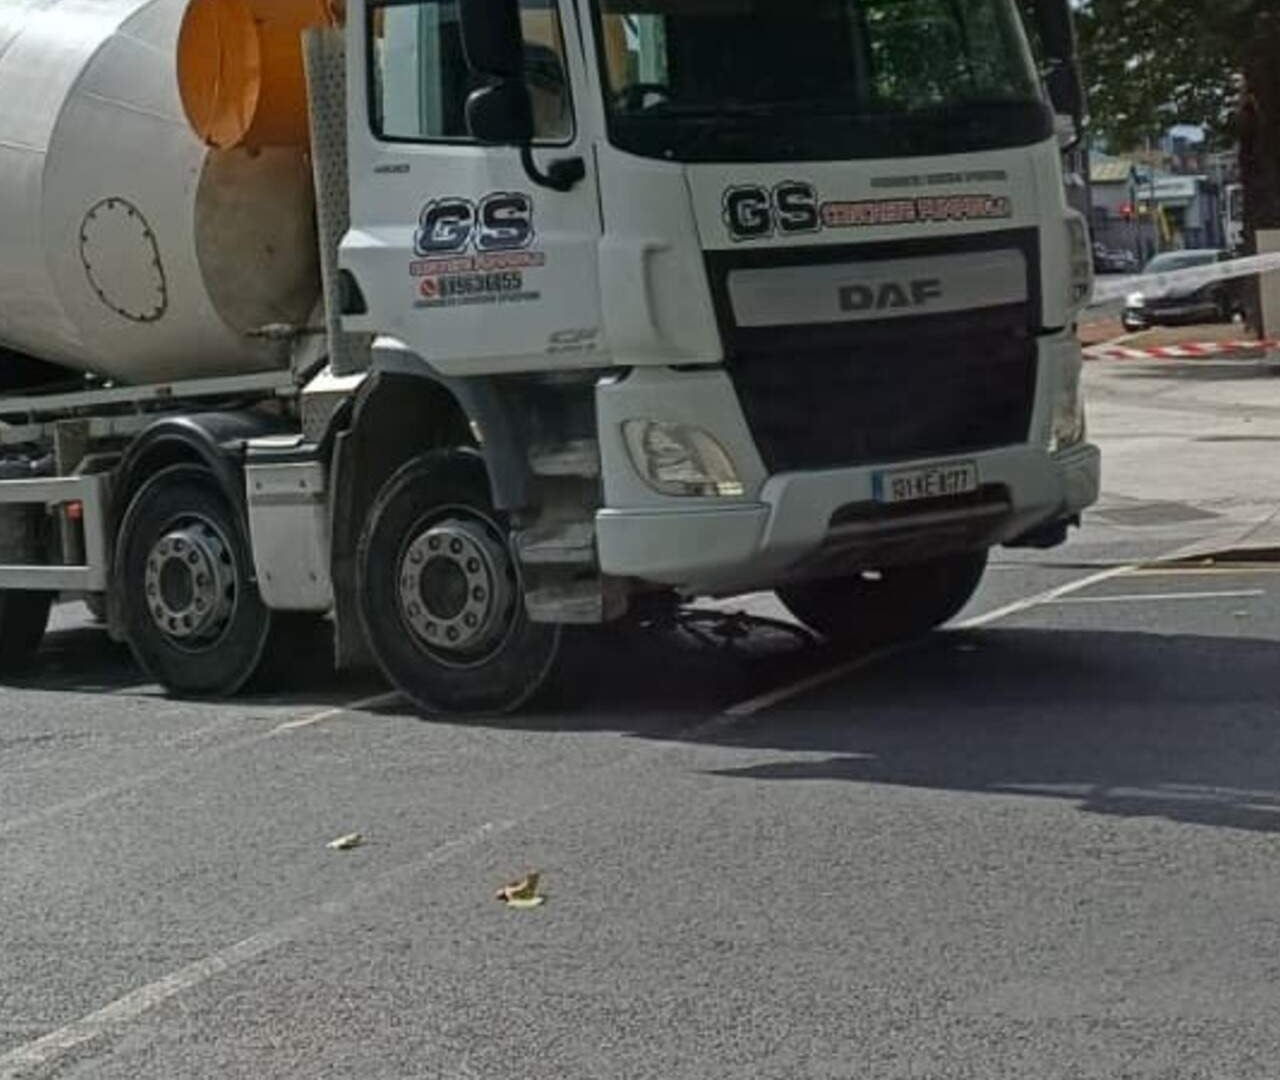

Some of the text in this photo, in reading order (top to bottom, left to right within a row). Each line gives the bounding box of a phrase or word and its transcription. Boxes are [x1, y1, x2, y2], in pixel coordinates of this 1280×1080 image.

[414, 191, 535, 257] GS
[723, 180, 821, 242] GS
[838, 278, 943, 312] DAF
